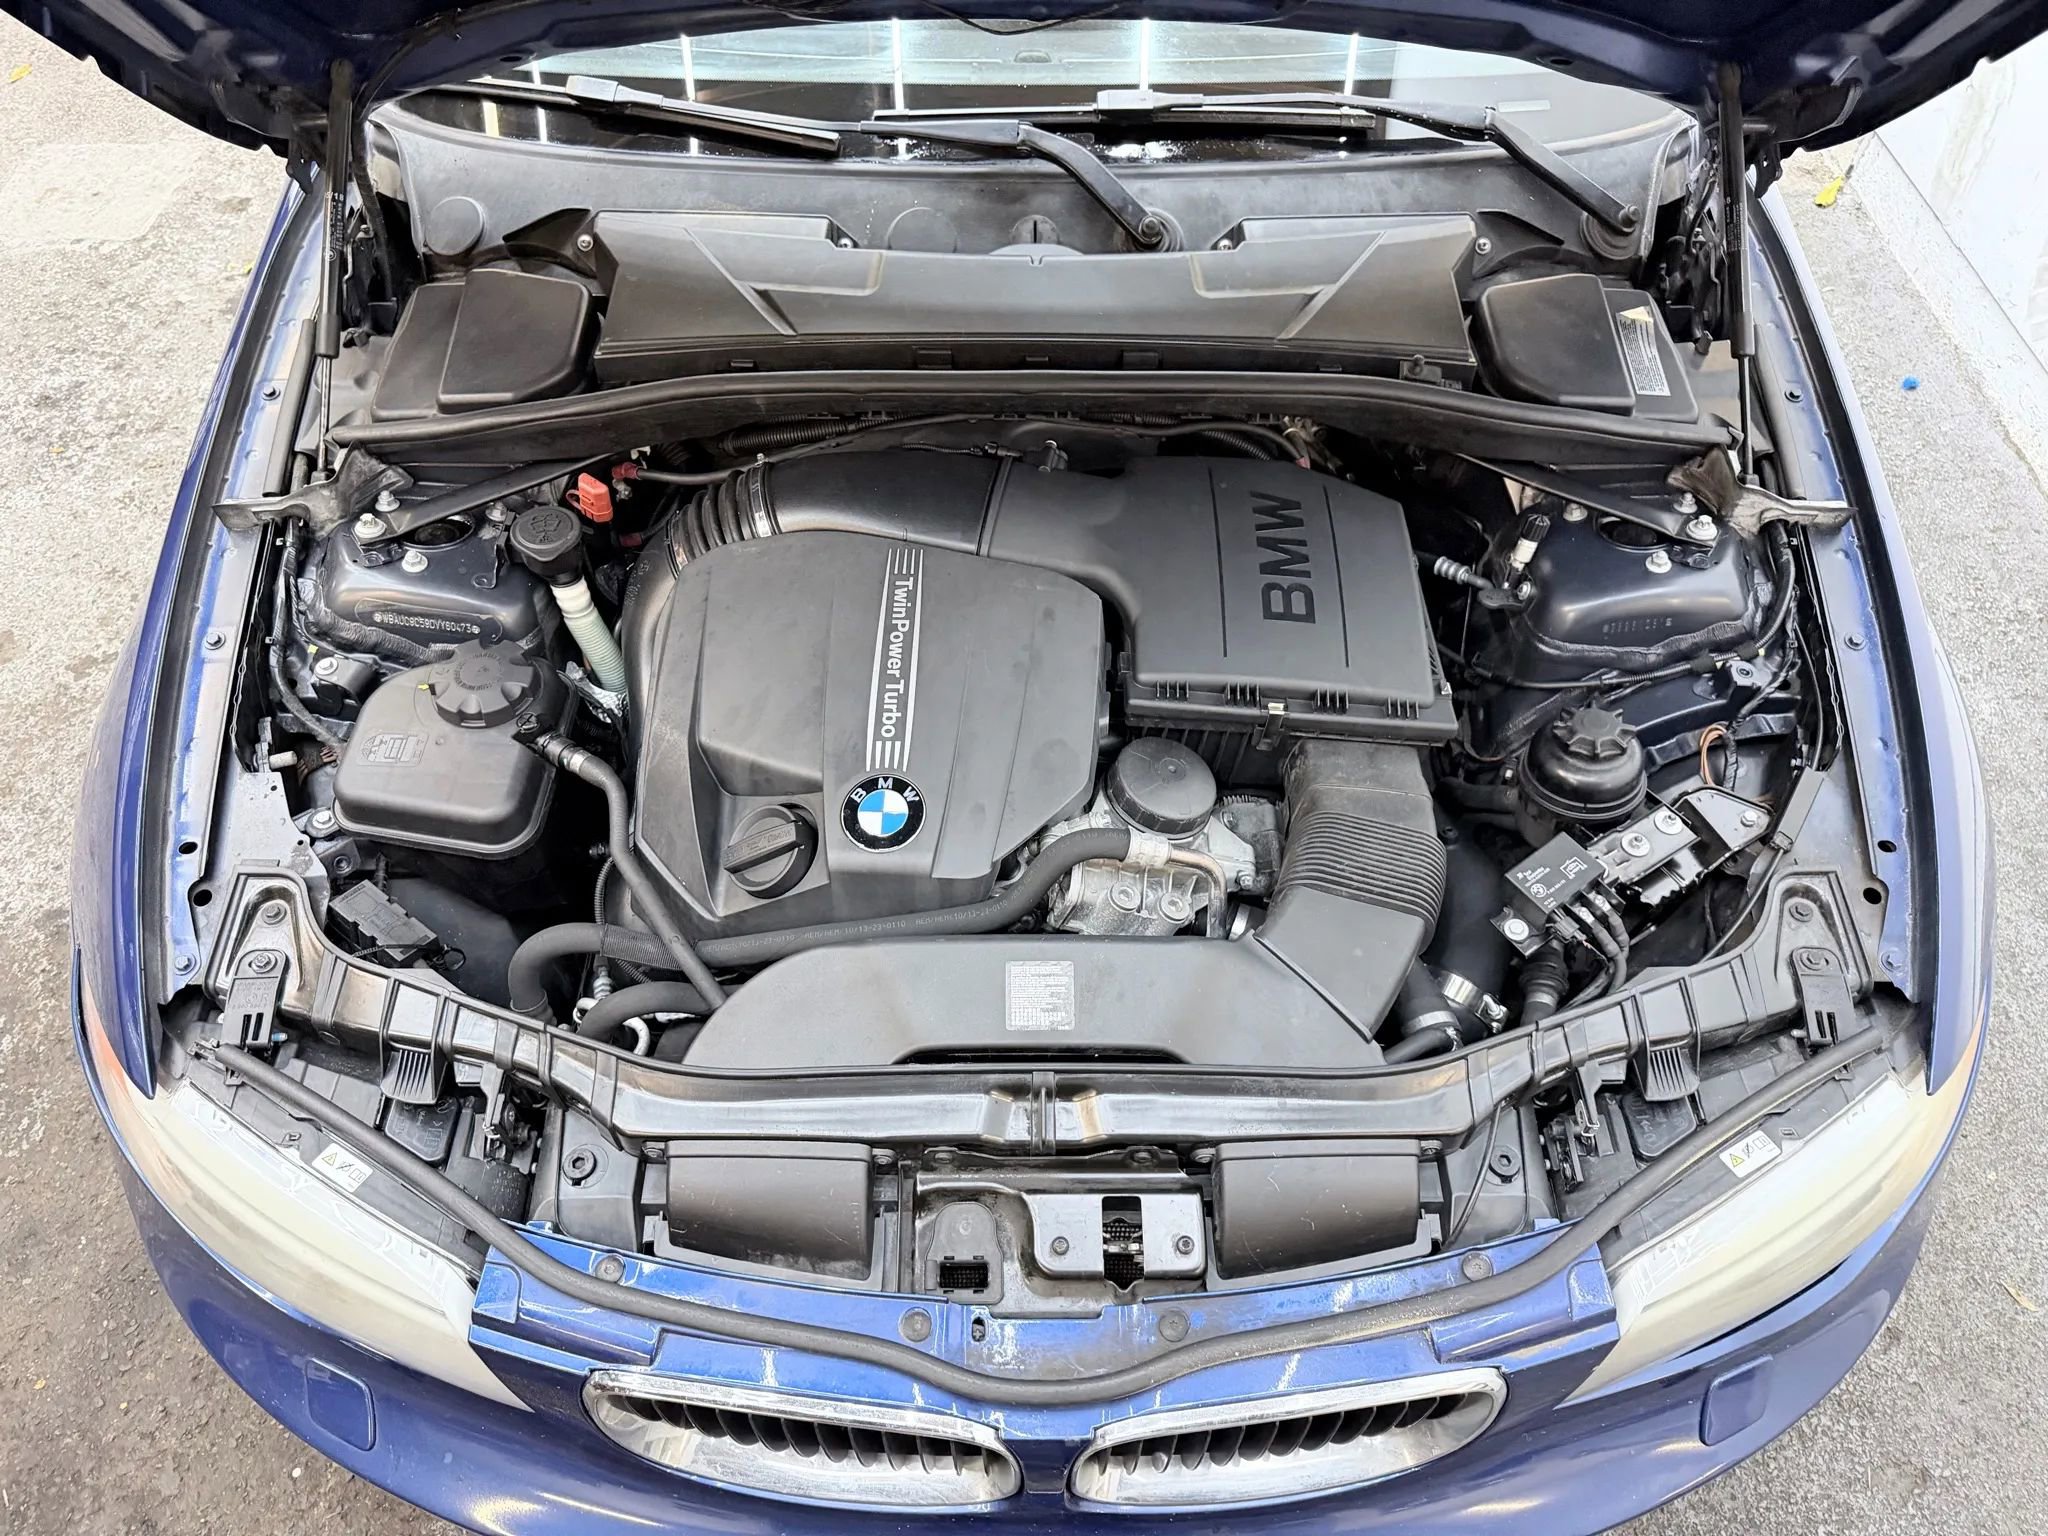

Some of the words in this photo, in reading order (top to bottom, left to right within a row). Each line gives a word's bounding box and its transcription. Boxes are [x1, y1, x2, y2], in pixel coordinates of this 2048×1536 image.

[1249, 490, 1316, 624] BMW
[885, 576, 914, 678] TwinPower
[880, 679, 905, 738] Turbo
[850, 777, 920, 803] BMW
